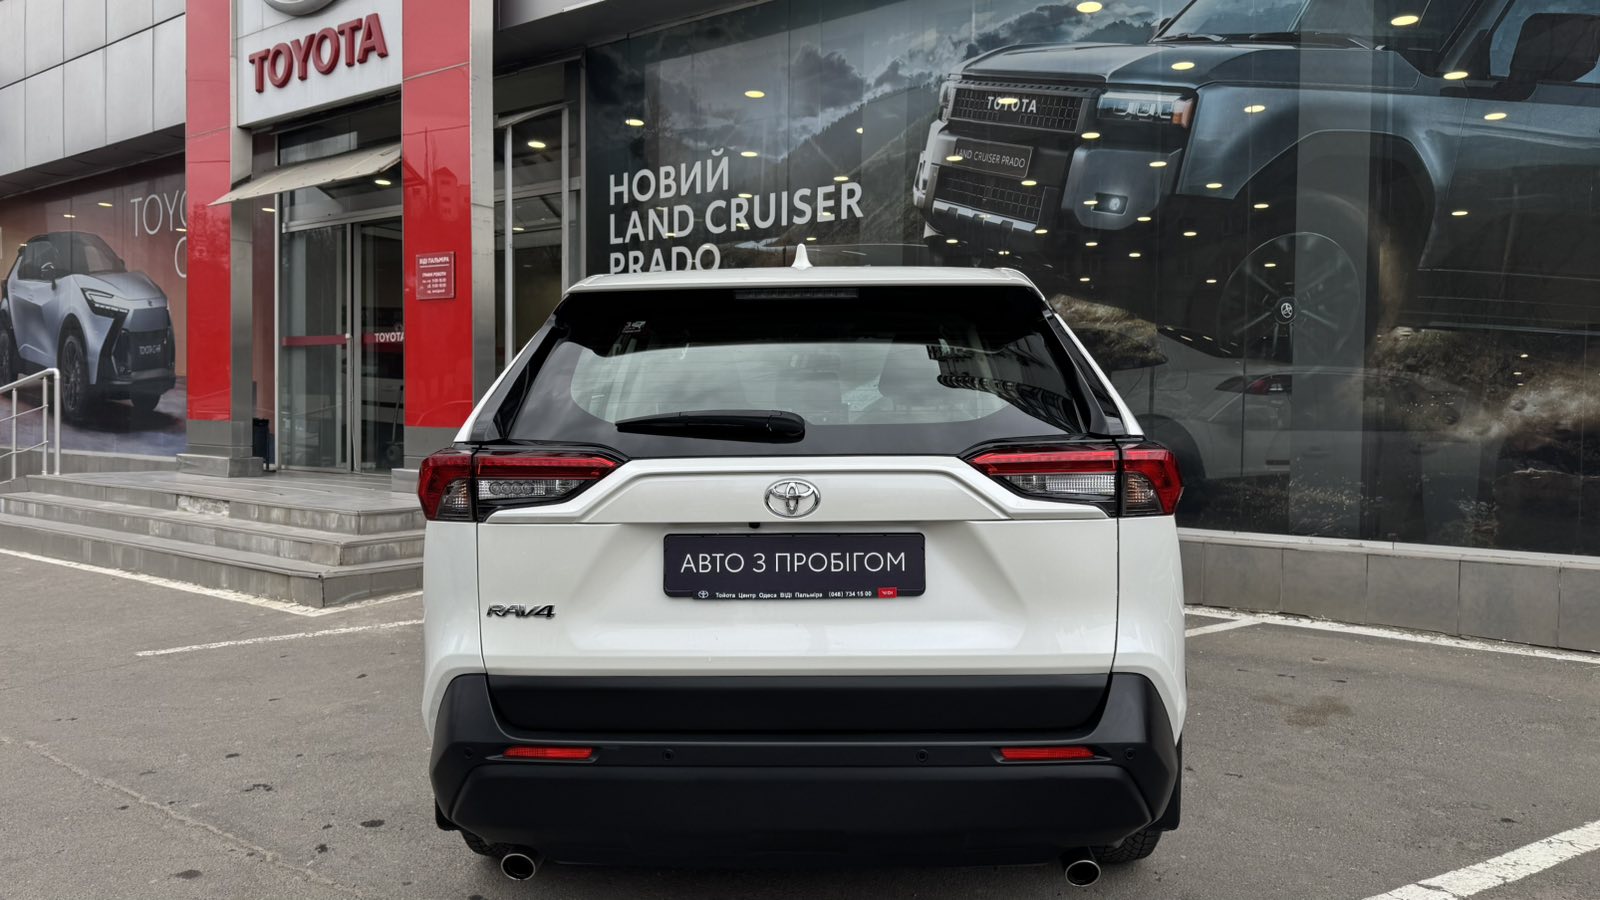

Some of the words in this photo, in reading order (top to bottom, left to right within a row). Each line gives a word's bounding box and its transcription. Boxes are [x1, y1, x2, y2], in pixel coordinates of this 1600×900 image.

[249, 13, 388, 93] TOYOTA
[973, 151, 1000, 164] CRUISER
[1000, 155, 1026, 168] PRADO
[609, 147, 729, 206] НОВИЙ
[609, 204, 695, 245] LAND
[705, 182, 865, 234] CRUISER
[609, 243, 722, 275] PRADO
[680, 552, 745, 573] АВТО
[752, 552, 766, 573] З
[775, 551, 906, 573] ПРОБІГОМ
[715, 591, 736, 599] Тойота
[738, 591, 757, 600] Центр
[758, 591, 777, 600] Одеса
[845, 590, 856, 598] 734
[486, 603, 556, 619] RAV4
